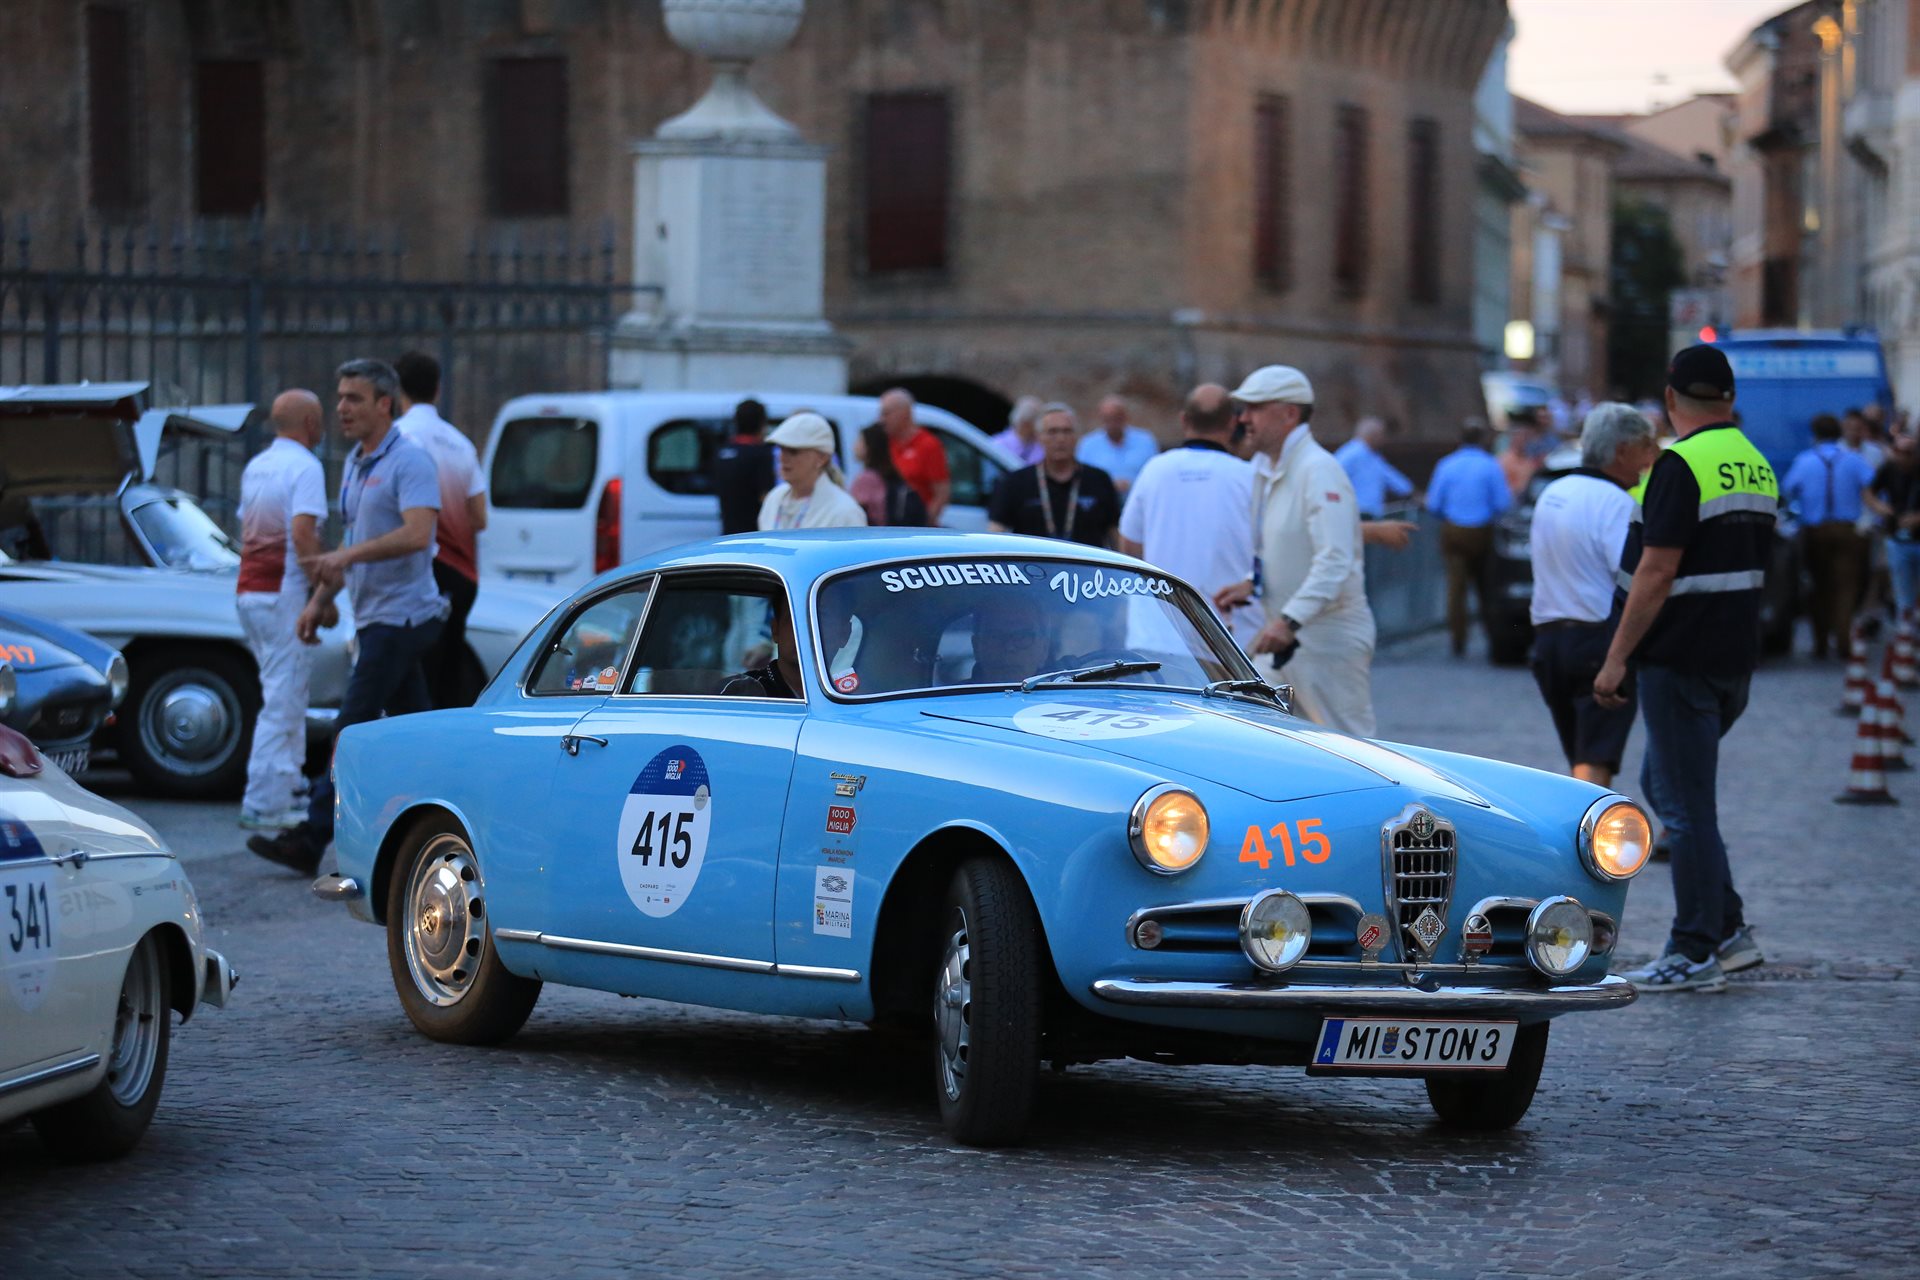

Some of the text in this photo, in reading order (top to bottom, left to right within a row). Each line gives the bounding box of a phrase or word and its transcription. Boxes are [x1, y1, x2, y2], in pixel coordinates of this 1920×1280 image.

[1718, 462, 1773, 492] STAFF
[881, 564, 1173, 603] SCUDERIA Velsecco
[1042, 710, 1161, 730] 415
[831, 809, 850, 819] 1000
[828, 821, 850, 832] MIGLIA
[631, 811, 694, 869] 415
[1239, 818, 1331, 869] 415
[5, 881, 51, 953] 341
[825, 910, 850, 921] MARINA
[825, 921, 850, 929] MILITARE
[1361, 930, 1373, 943] 1000
[1323, 1047, 1332, 1058] A
[1346, 1026, 1380, 1059] MI
